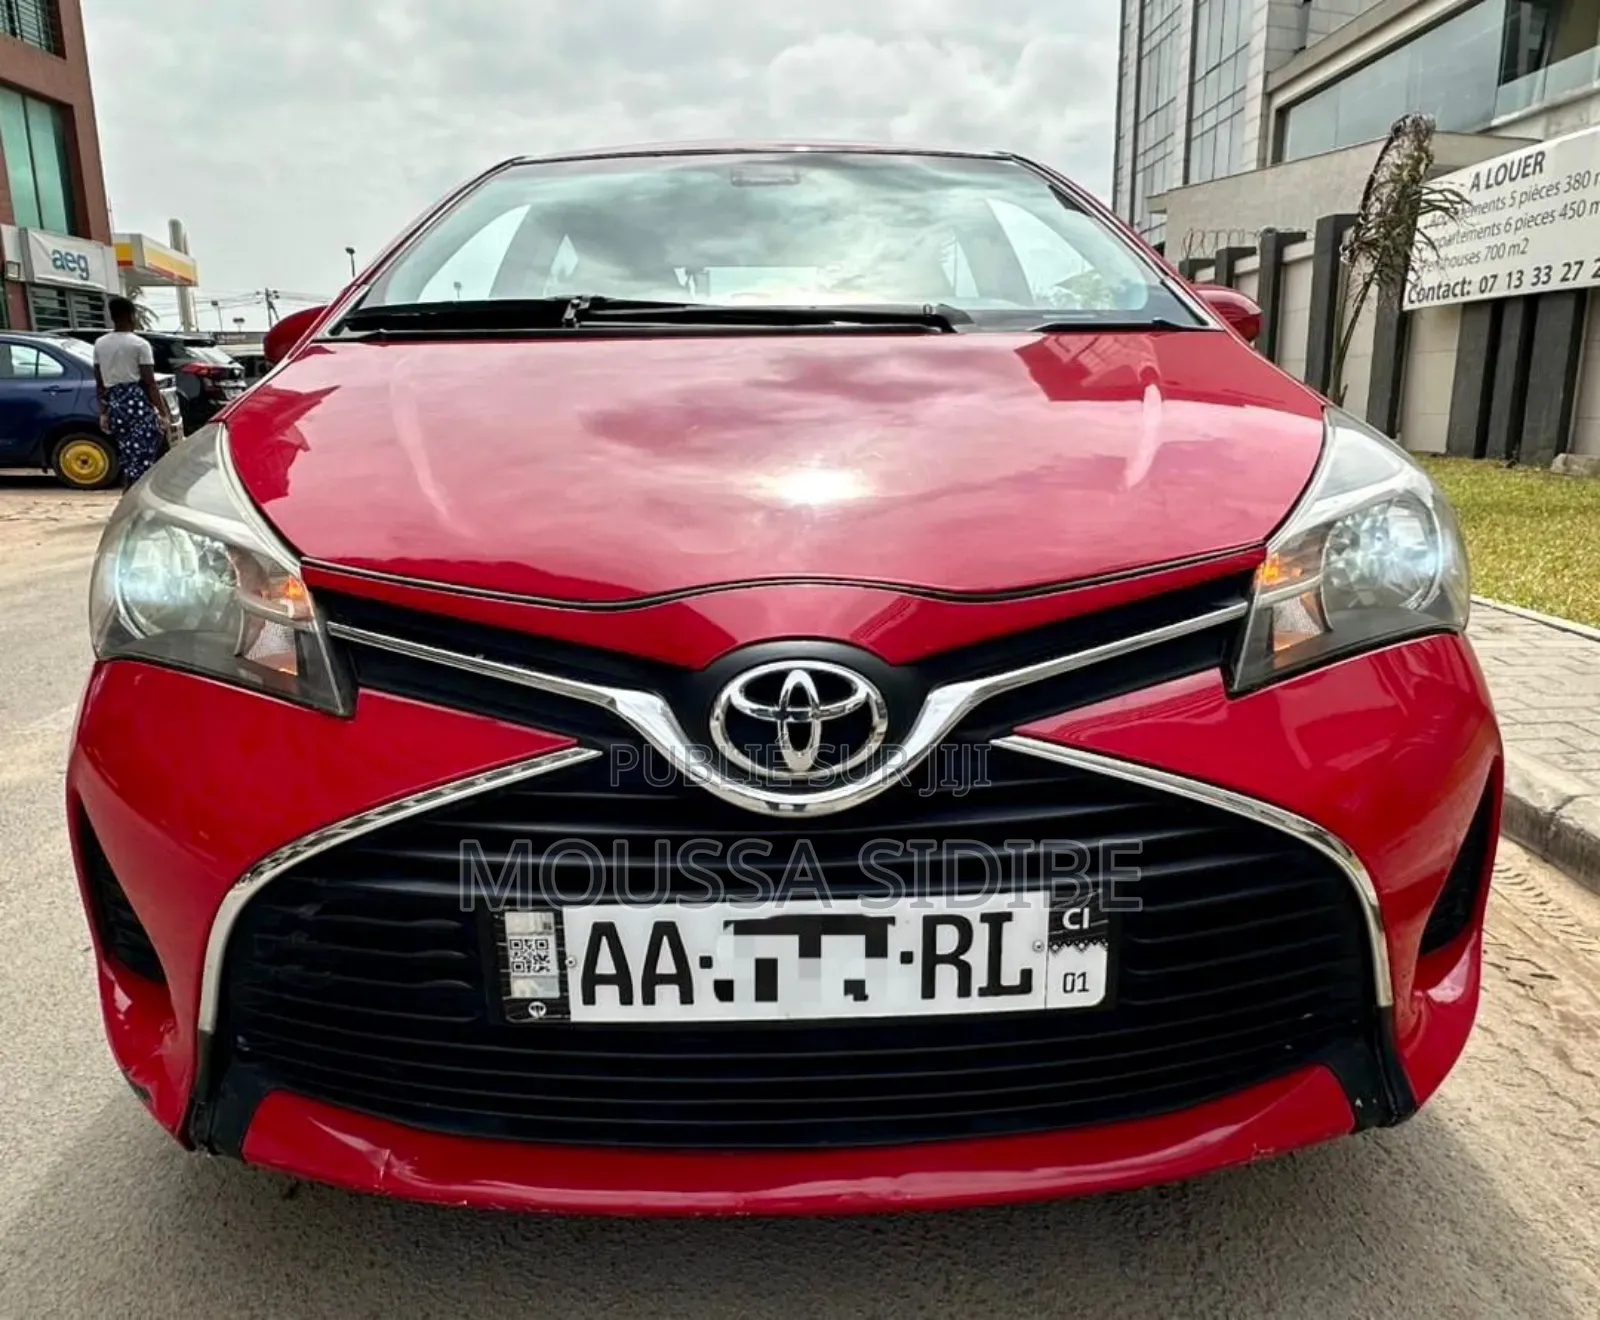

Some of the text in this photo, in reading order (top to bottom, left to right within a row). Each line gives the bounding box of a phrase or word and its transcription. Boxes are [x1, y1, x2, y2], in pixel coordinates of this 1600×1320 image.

[1469, 151, 1546, 194] A LOUER
[1509, 190, 1518, 208] 5
[1563, 170, 1592, 194] 380
[1504, 216, 1513, 234] 6
[1558, 199, 1587, 221] 450
[52, 249, 90, 281] aeg
[1483, 242, 1506, 261] 700
[1507, 237, 1530, 257] m2
[1408, 276, 1472, 304] Contact:
[1479, 274, 1498, 294] 07
[1506, 269, 1524, 290] 13
[1531, 264, 1553, 287] 33
[1560, 260, 1585, 283] 27
[1062, 907, 1091, 930] CI
[1062, 971, 1090, 994] 01
